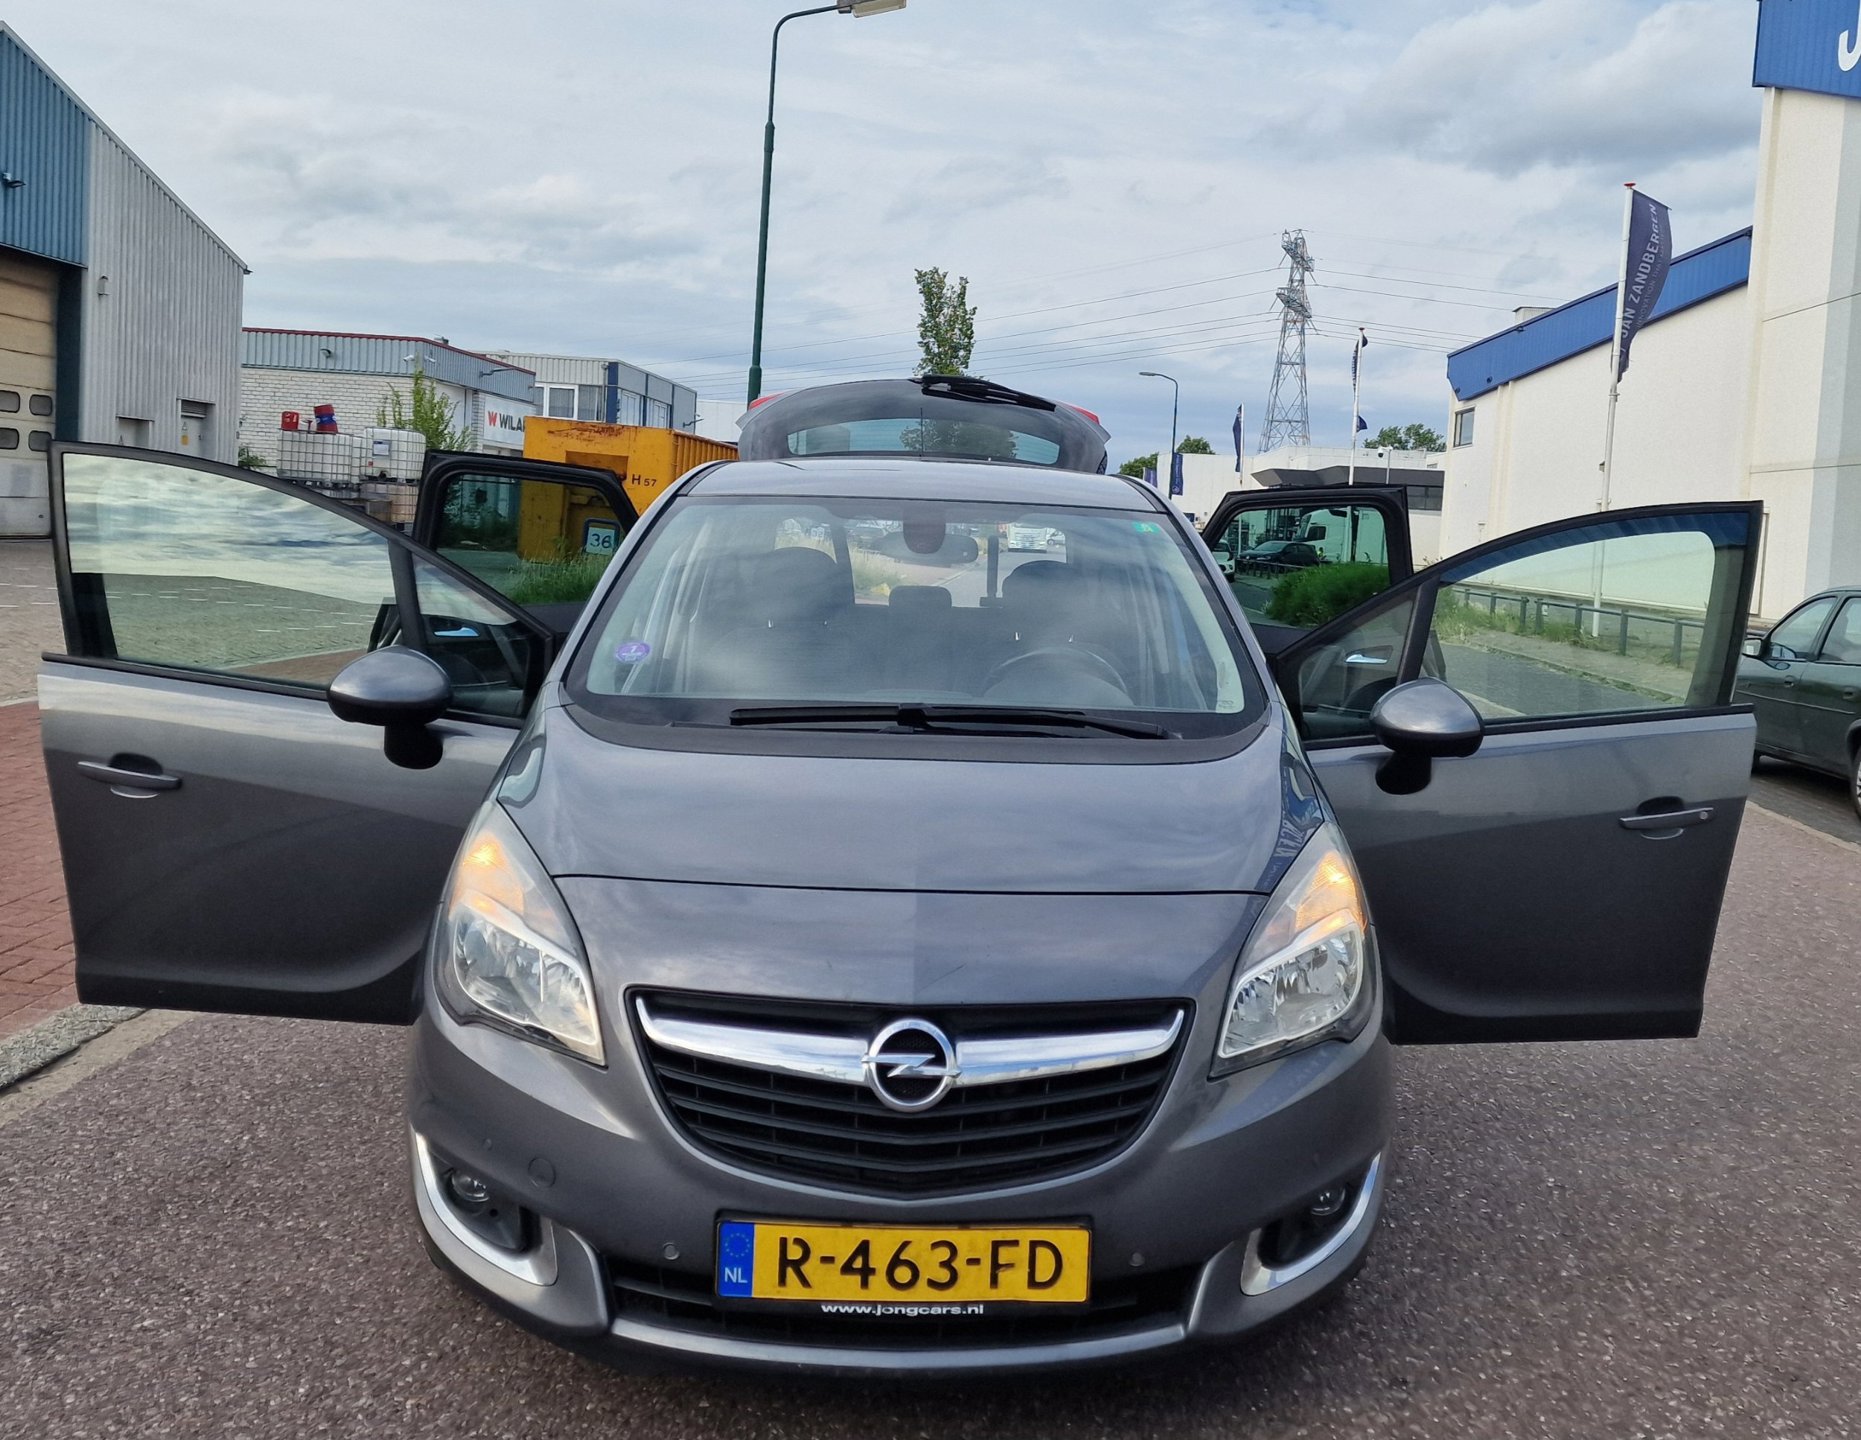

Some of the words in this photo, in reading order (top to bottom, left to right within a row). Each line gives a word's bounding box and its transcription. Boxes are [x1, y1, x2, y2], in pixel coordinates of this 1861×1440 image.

[1621, 307, 1636, 339] JAN
[1629, 203, 1660, 304] ZANDBERGEN
[632, 473, 641, 486] H
[644, 478, 657, 487] 57
[590, 533, 611, 549] 36
[777, 1236, 1064, 1291] R-463-FD
[724, 1266, 749, 1284] NL
[821, 1303, 984, 1317] www.jongcars.nl
